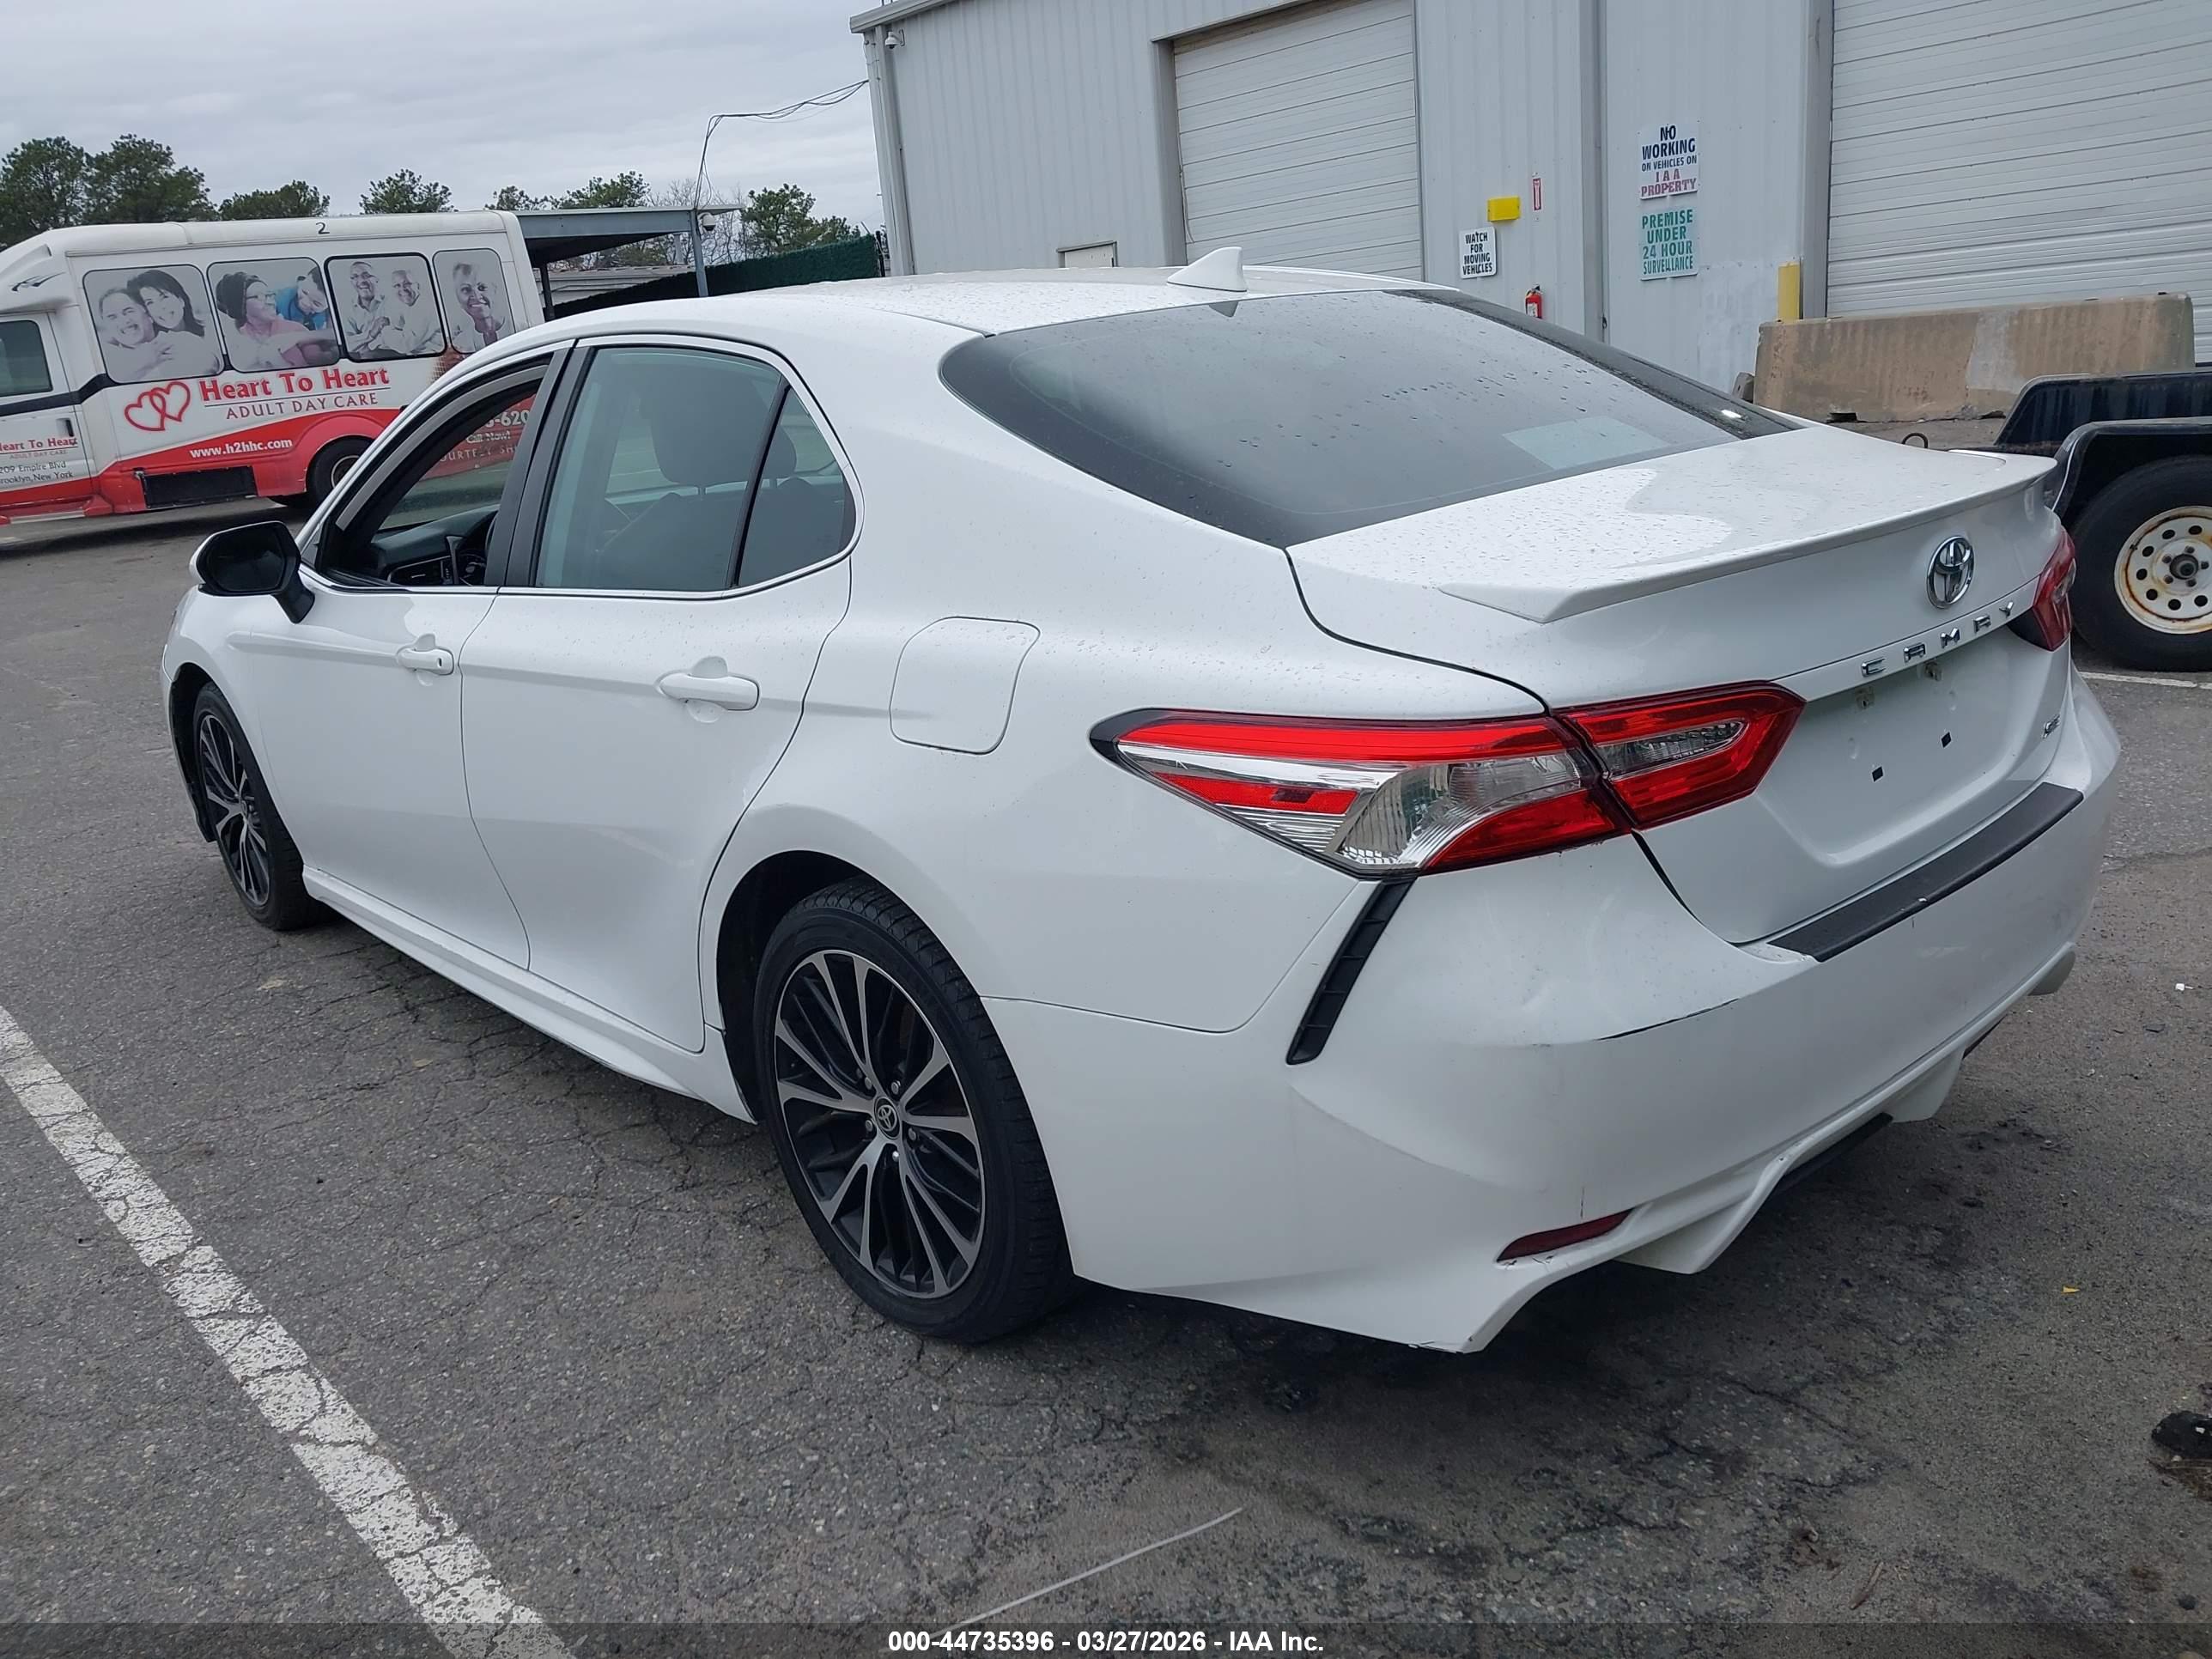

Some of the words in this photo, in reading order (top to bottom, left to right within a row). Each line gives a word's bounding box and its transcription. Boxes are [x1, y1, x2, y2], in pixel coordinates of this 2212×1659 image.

[1660, 125, 1676, 141] NO
[1642, 137, 1696, 160] WORKING
[1642, 162, 1651, 172] ON
[1653, 156, 1684, 170] VEHICLES
[1686, 155, 1697, 165] ON
[1641, 178, 1697, 197] PROPERTY
[1642, 209, 1693, 229] PREMISE
[315, 222, 330, 234] 2
[1647, 226, 1686, 244] UNDER
[1465, 231, 1488, 244] WATCH
[1470, 243, 1483, 253] FOR
[1643, 245, 1656, 259] 24
[1662, 240, 1692, 257] HOUR
[1464, 252, 1490, 264] MOVING
[1643, 255, 1693, 275] SURVEILLANCE
[1462, 262, 1492, 275] VEHICLES
[198, 378, 272, 402] Heart
[279, 372, 313, 393] To
[321, 368, 390, 389] Heart
[226, 402, 285, 420] ADULT
[293, 397, 326, 412] DAY
[334, 392, 379, 408] CARE
[27, 439, 43, 448] To
[47, 437, 77, 447] Heart
[189, 439, 293, 459] www.h2hhc.com
[48, 460, 66, 470] Blvd
[0, 475, 33, 484] rooklyn,
[54, 471, 74, 479] York
